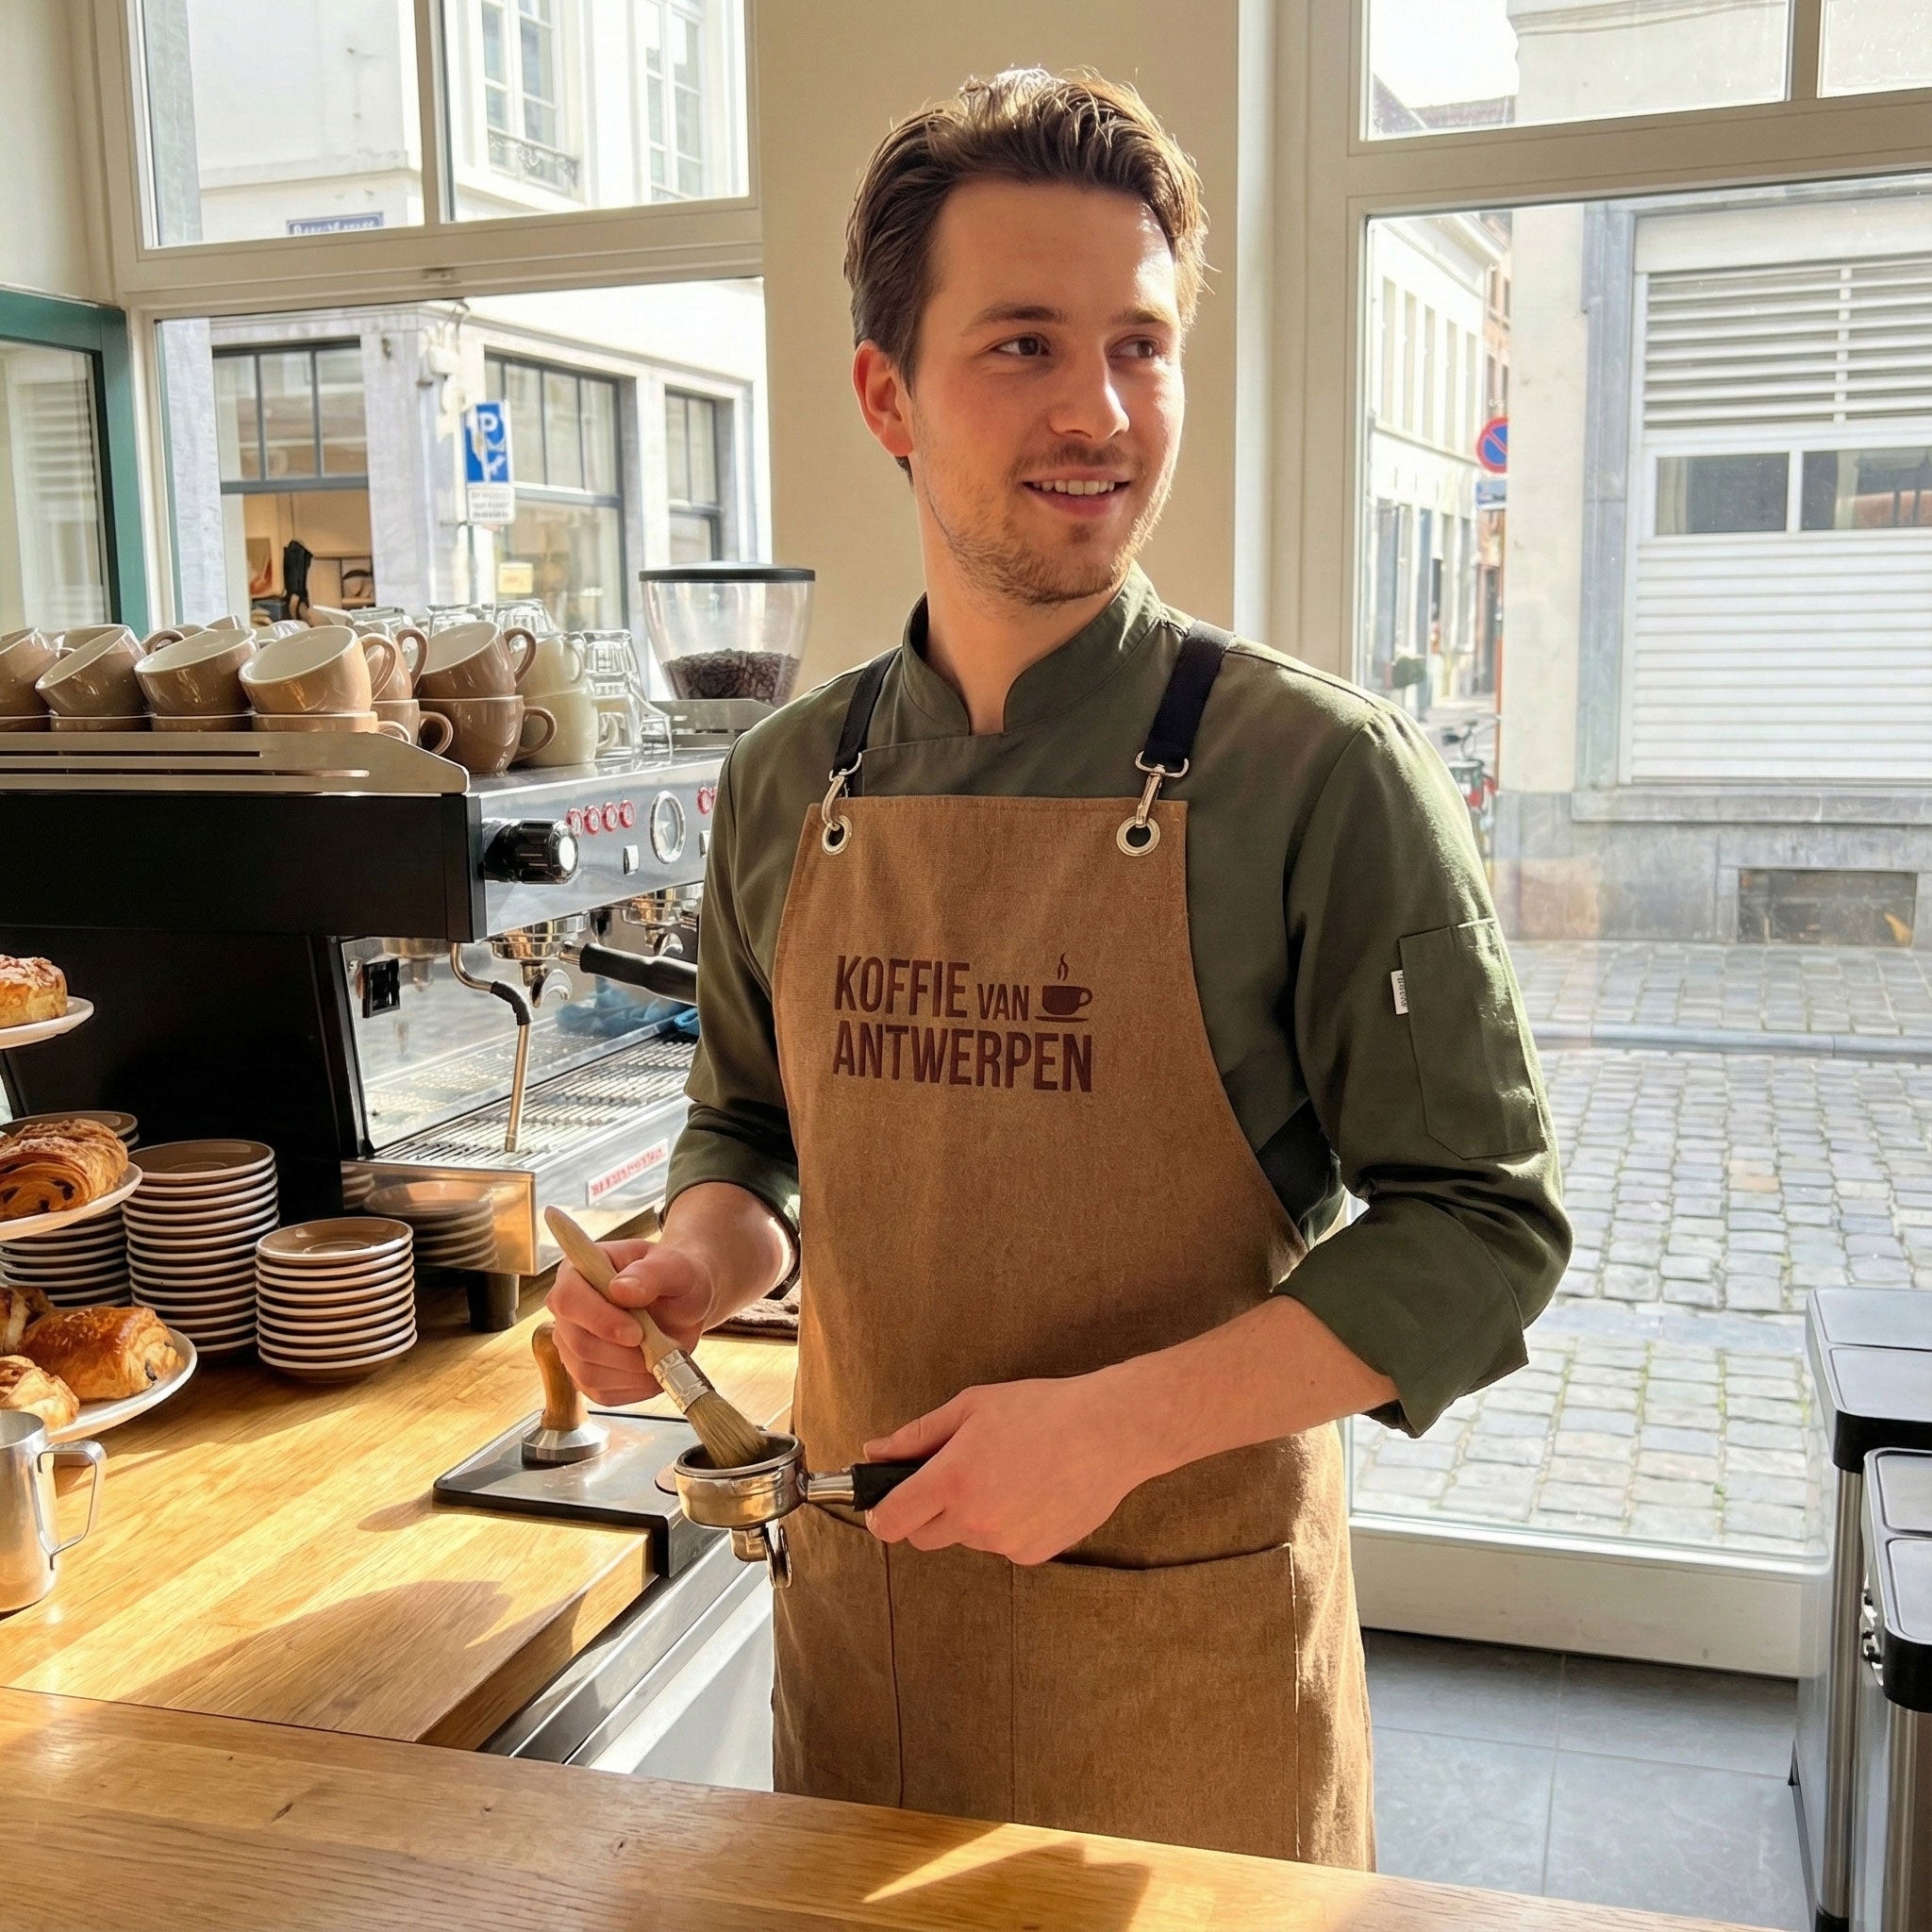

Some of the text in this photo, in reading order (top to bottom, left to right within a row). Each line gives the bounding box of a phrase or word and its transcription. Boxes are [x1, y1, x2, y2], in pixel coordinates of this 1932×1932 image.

[834, 955, 1029, 1022] KOFFIE VAN
[832, 1020, 1092, 1092] ANTWERPEN
